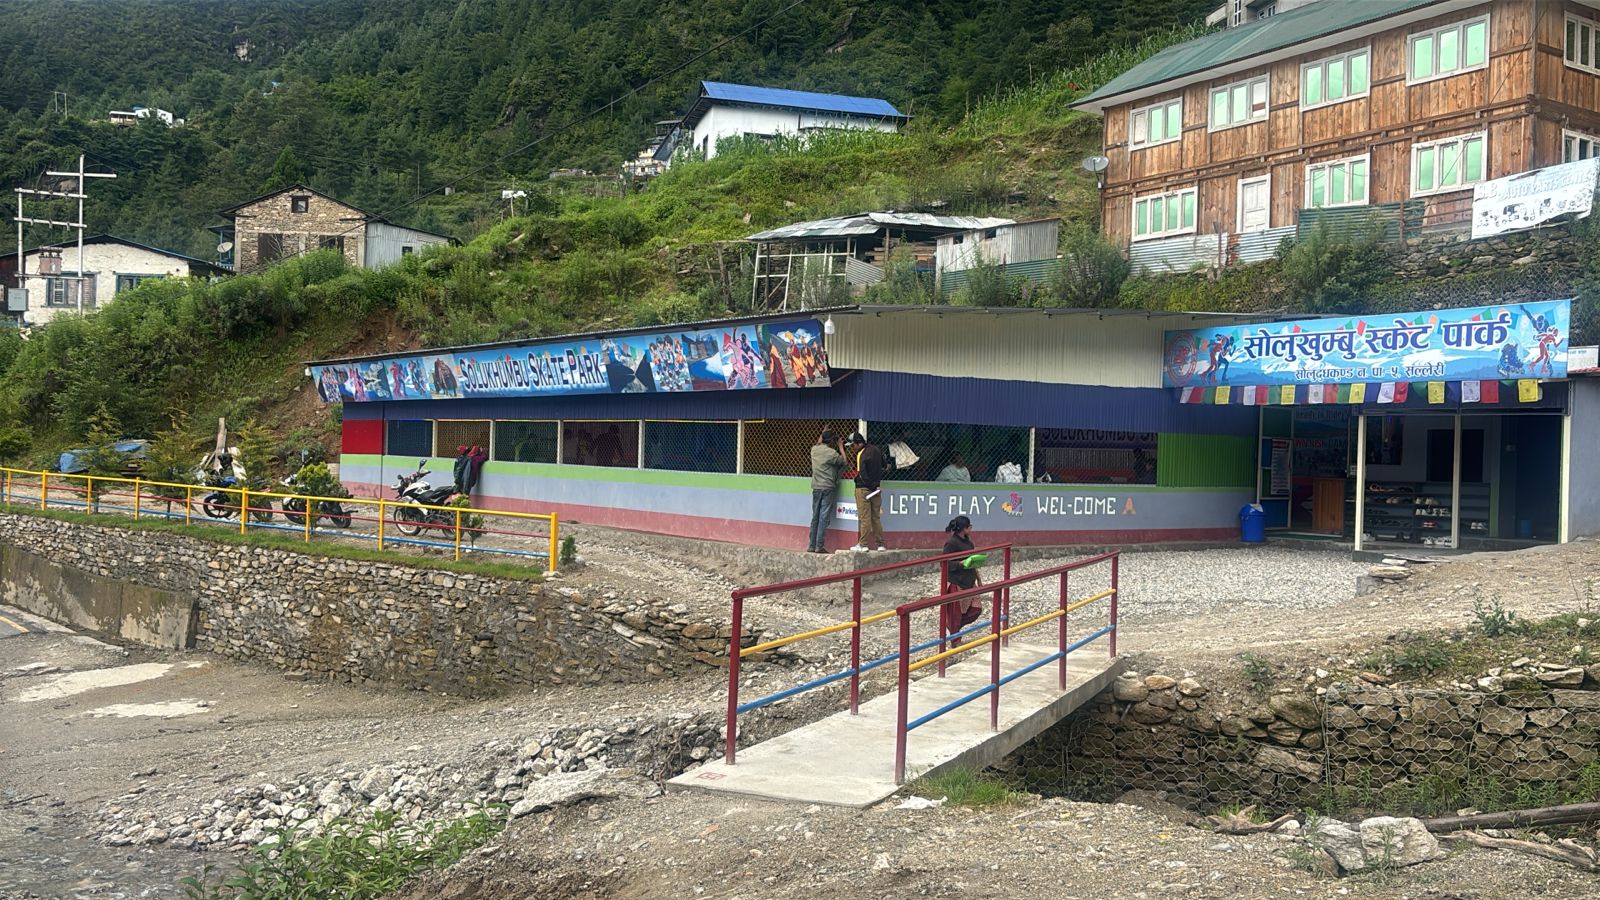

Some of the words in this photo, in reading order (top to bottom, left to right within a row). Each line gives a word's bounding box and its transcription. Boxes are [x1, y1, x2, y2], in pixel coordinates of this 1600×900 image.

[1244, 329, 1357, 361] सोलुखुम्बु
[1365, 319, 1432, 354] स्केट
[1442, 313, 1510, 348] पार्क
[459, 358, 530, 390] SOLUKHUMBU
[527, 352, 569, 387] SKATE
[566, 349, 606, 384] PARK
[889, 492, 938, 516] LET'S
[948, 495, 996, 515] PLAY
[1036, 496, 1116, 516] WEL-COME
